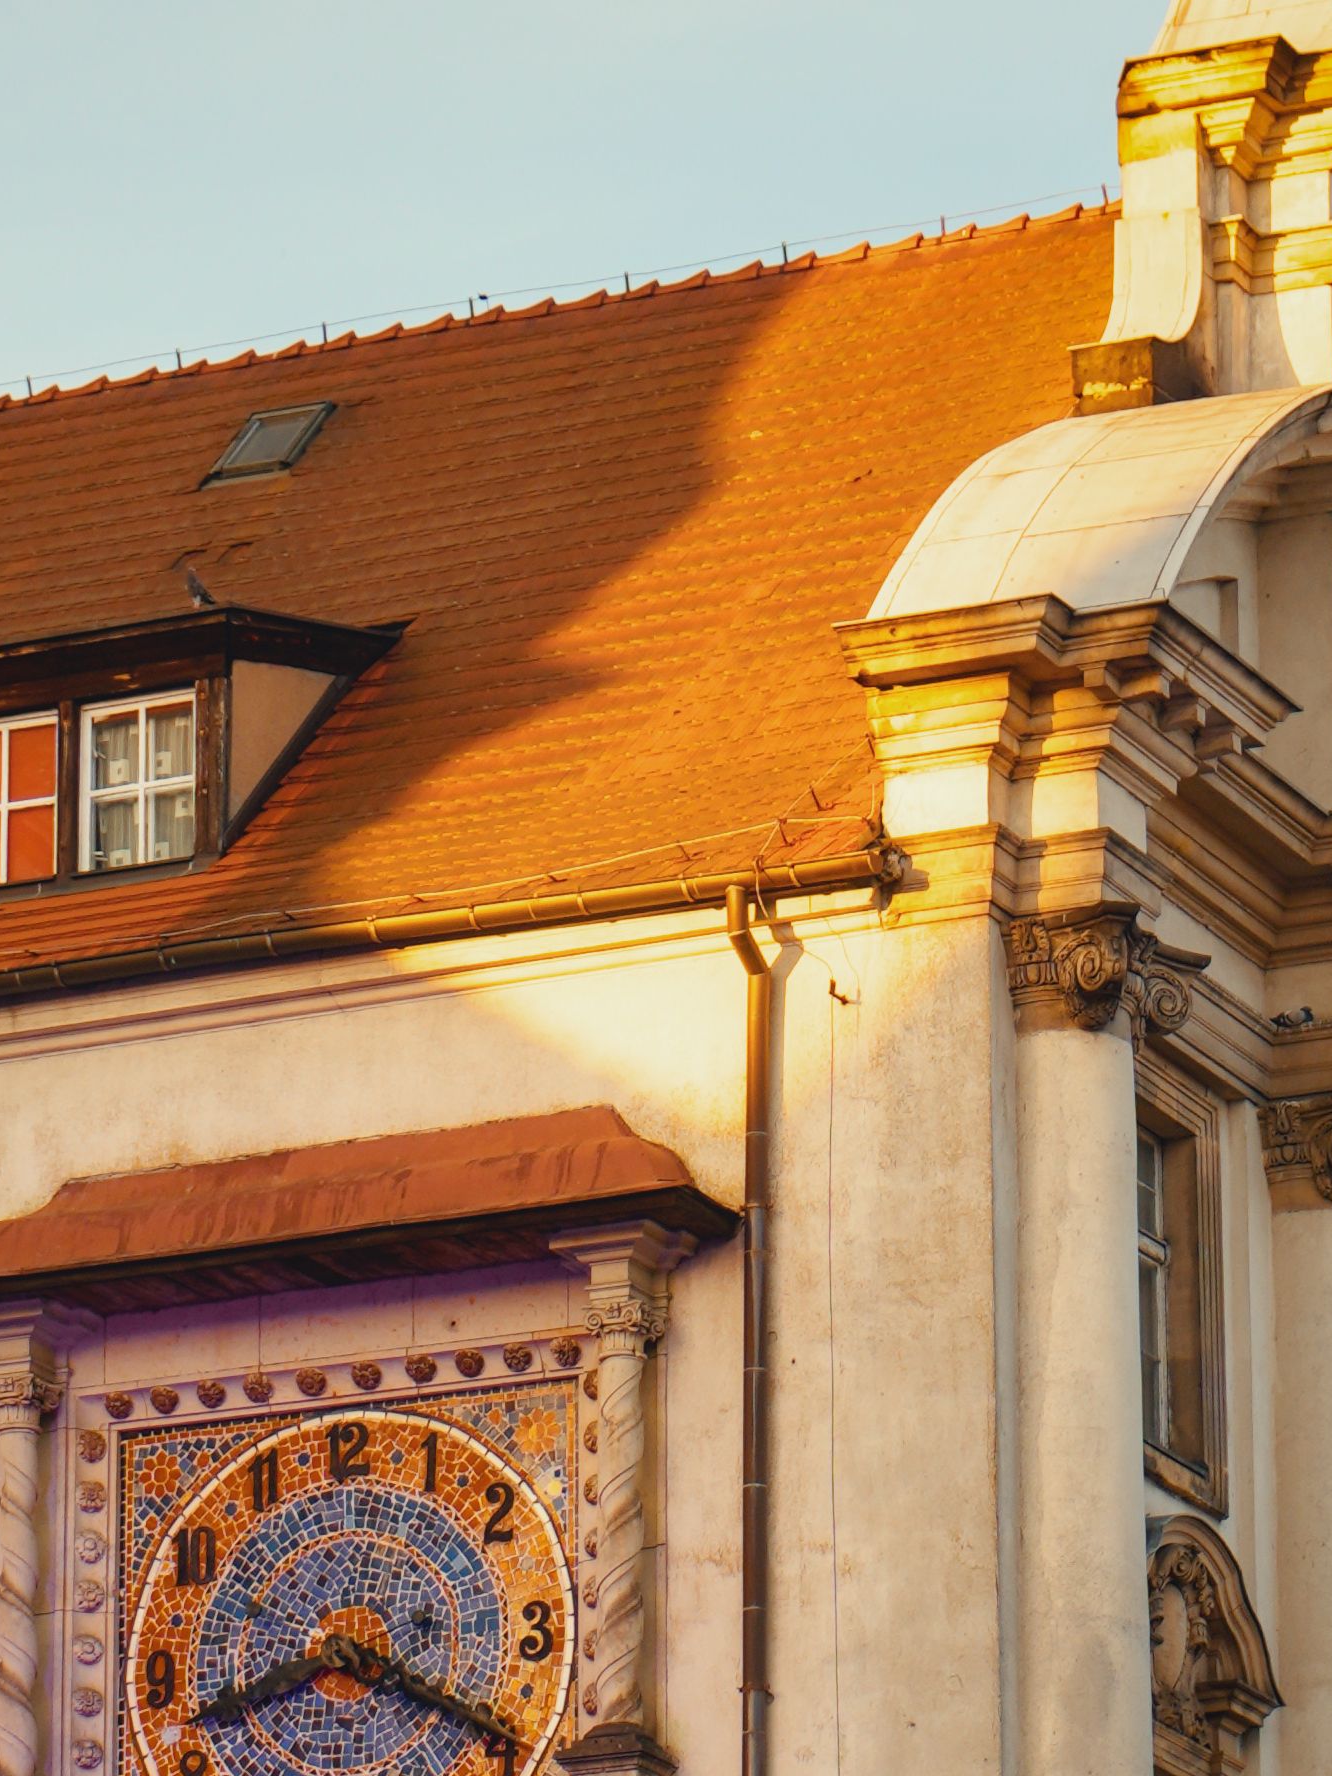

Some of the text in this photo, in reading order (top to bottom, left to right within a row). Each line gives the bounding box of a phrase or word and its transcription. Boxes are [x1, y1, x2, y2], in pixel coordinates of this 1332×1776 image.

[248, 1447, 280, 1512] 11
[325, 1423, 369, 1484] 12
[421, 1432, 438, 1491] 1
[483, 1483, 515, 1543] 2
[173, 1526, 216, 1586] 10
[519, 1600, 553, 1661] 3
[146, 1650, 175, 1709] 9
